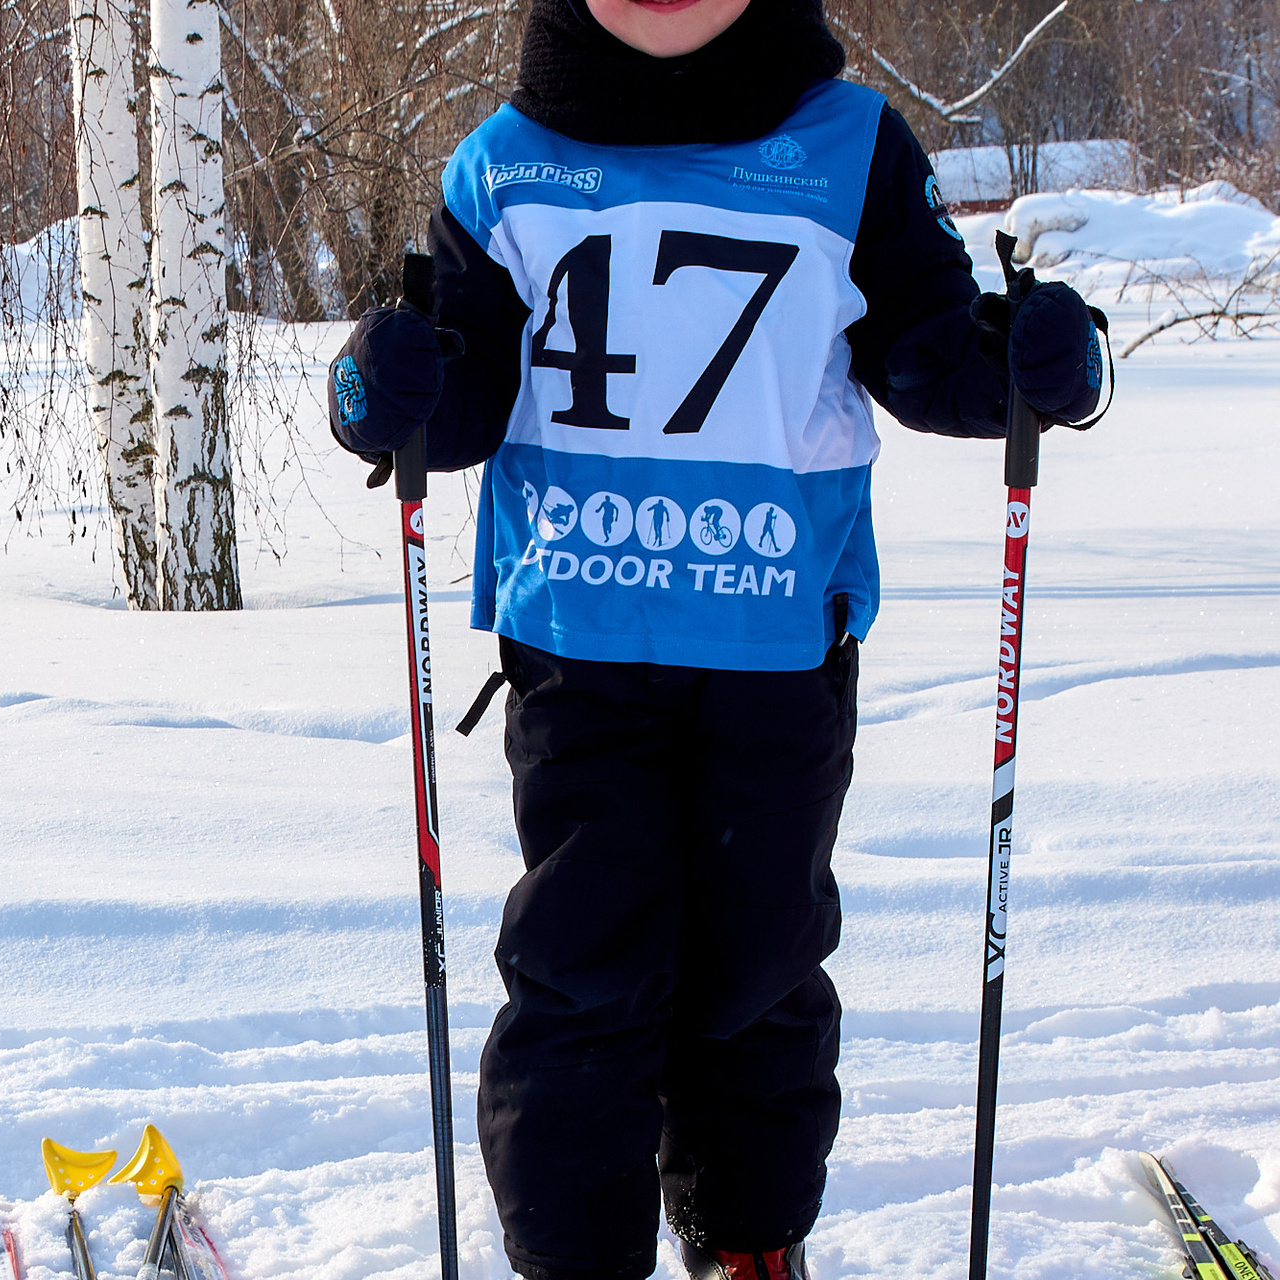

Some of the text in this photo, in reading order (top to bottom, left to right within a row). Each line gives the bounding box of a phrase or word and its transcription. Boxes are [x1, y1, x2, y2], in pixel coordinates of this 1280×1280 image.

[733, 165, 829, 188] Пушкинский
[531, 230, 800, 435] 47
[687, 563, 796, 597] TEAM
[995, 565, 1020, 744] NORDWAY
[998, 827, 1012, 855] JR
[998, 860, 1009, 913] ACTIVE
[434, 890, 443, 940] JUNIOR
